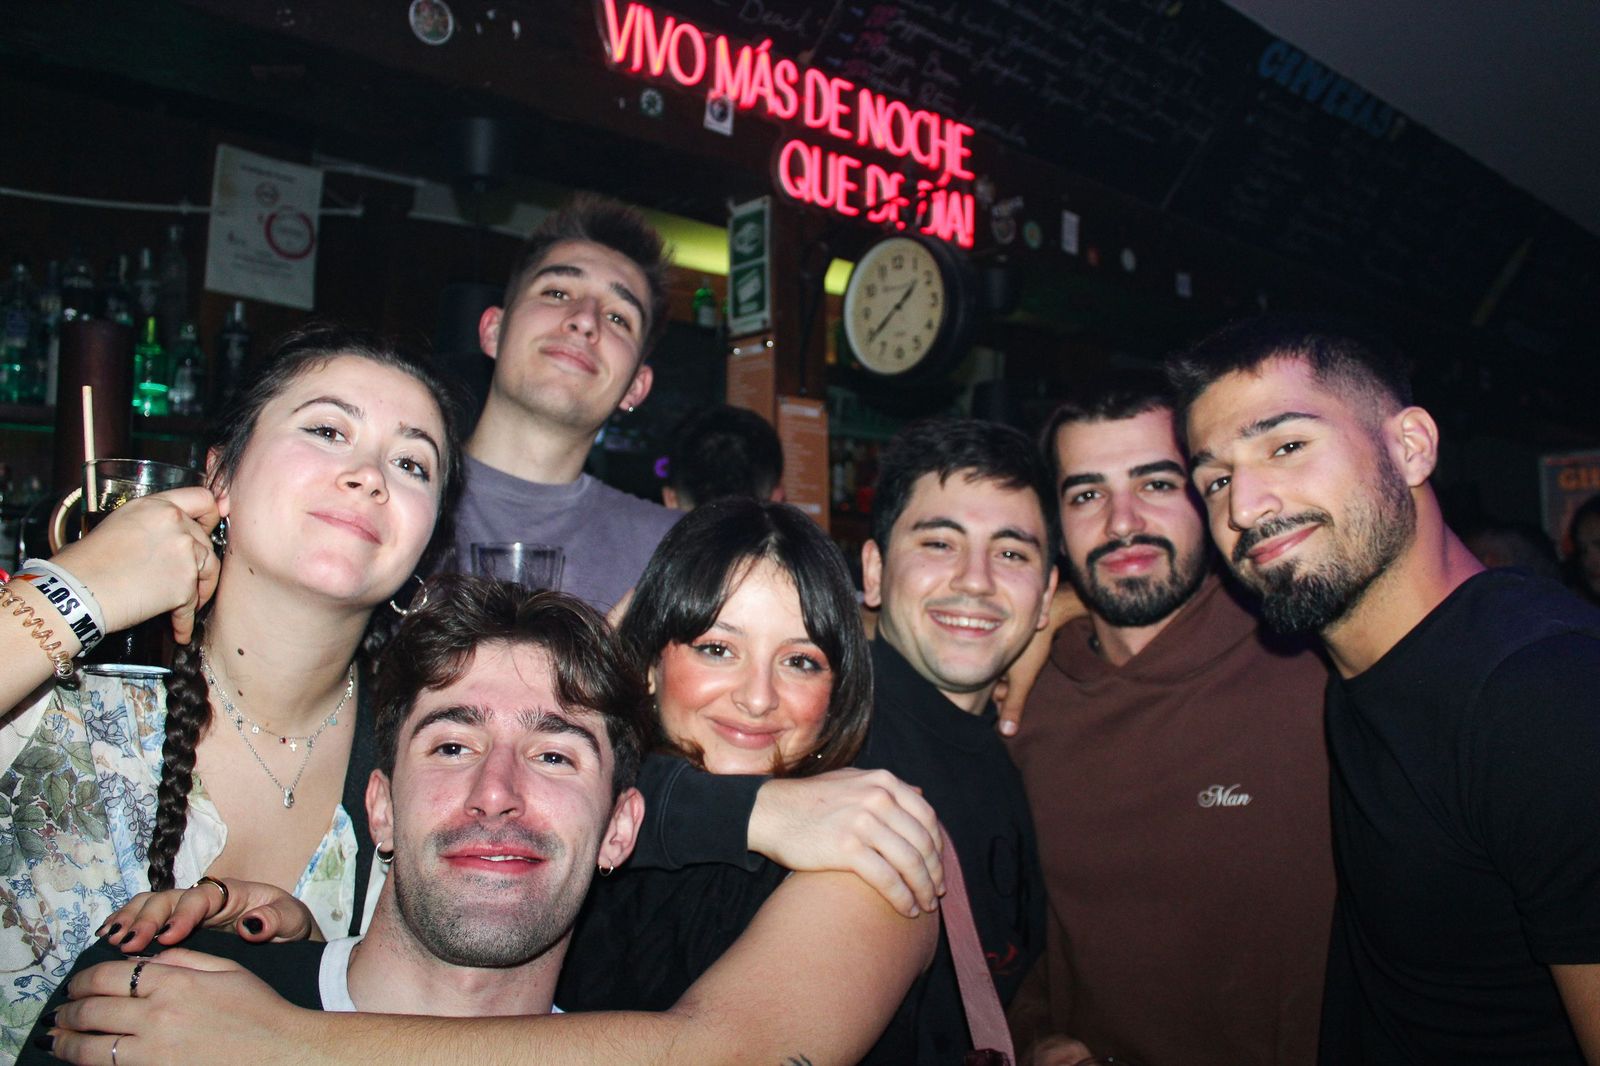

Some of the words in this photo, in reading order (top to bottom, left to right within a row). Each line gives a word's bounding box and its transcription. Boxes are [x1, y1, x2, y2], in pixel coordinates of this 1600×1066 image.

[605, 0, 707, 86] VIVO
[714, 34, 799, 120] MÁS
[804, 68, 855, 139] DE
[857, 87, 975, 181] NOCHE
[779, 139, 862, 216] QUE
[36, 576, 81, 617] LOS
[1197, 783, 1254, 808] Man
